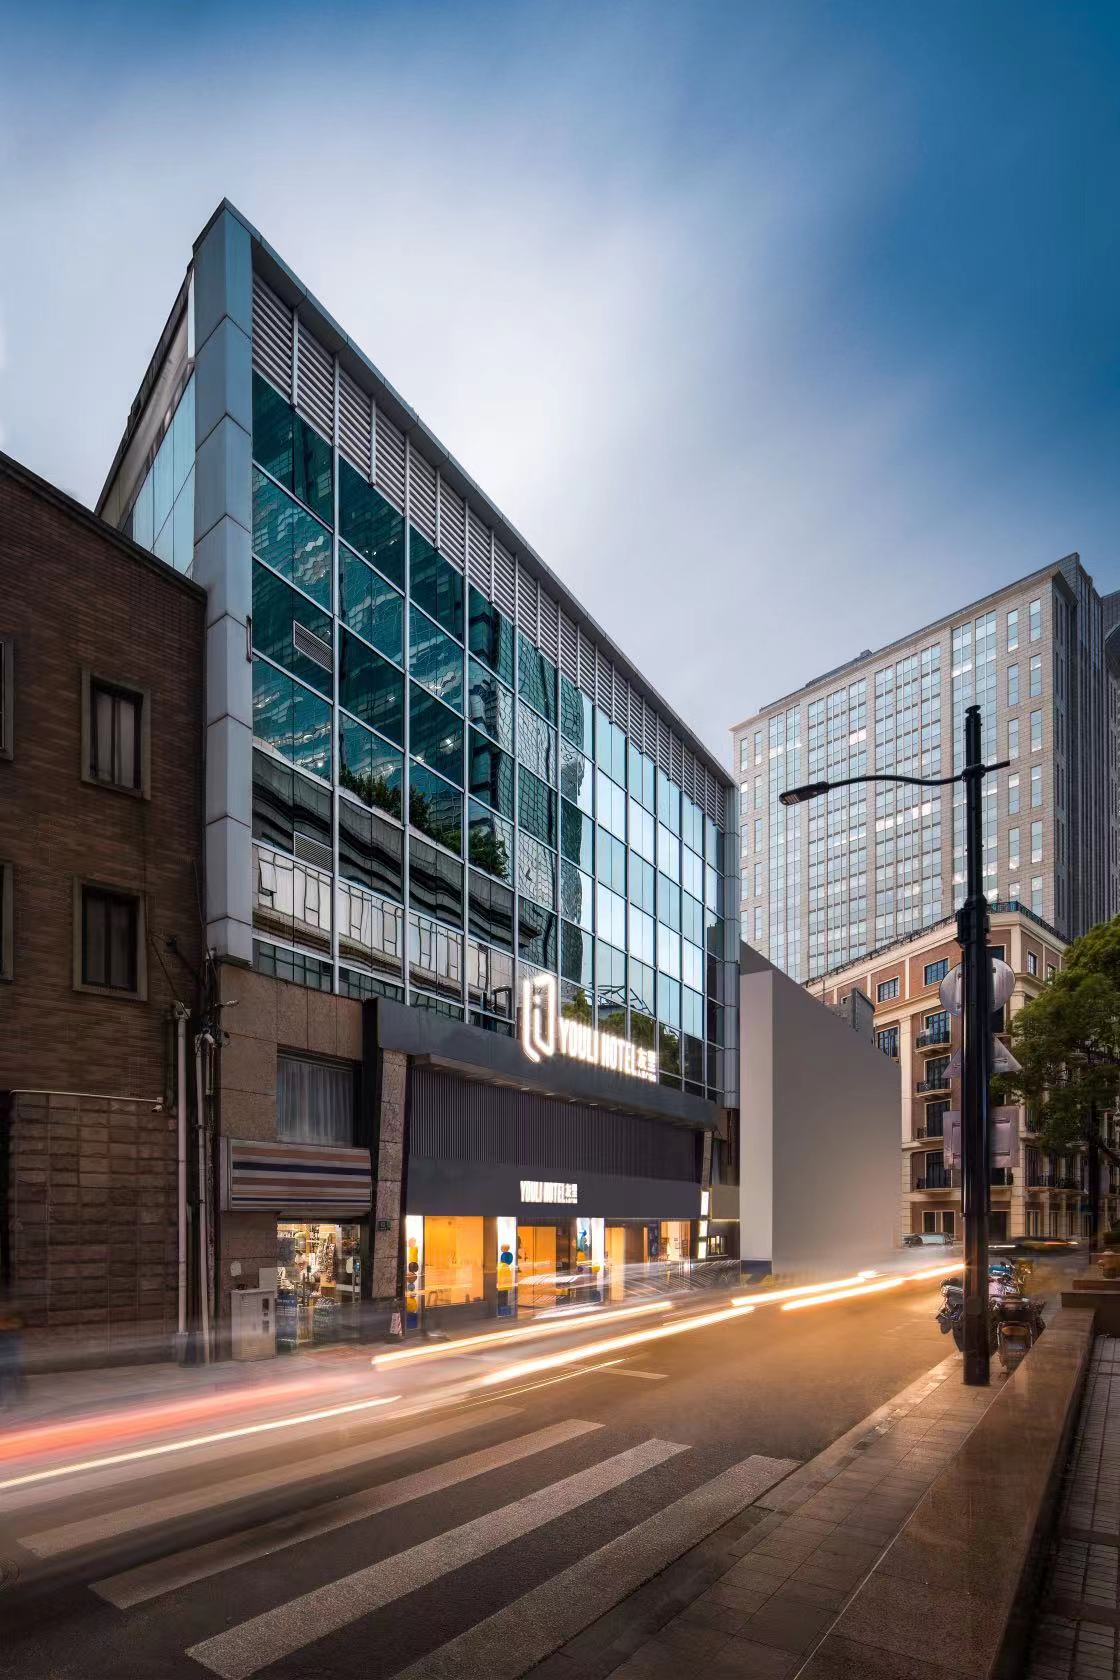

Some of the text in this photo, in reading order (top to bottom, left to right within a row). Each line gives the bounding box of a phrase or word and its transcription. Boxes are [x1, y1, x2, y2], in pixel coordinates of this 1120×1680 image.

[558, 1016, 636, 1076] YOULI HOTEL
[520, 1181, 565, 1203] YOULI HOTEL
